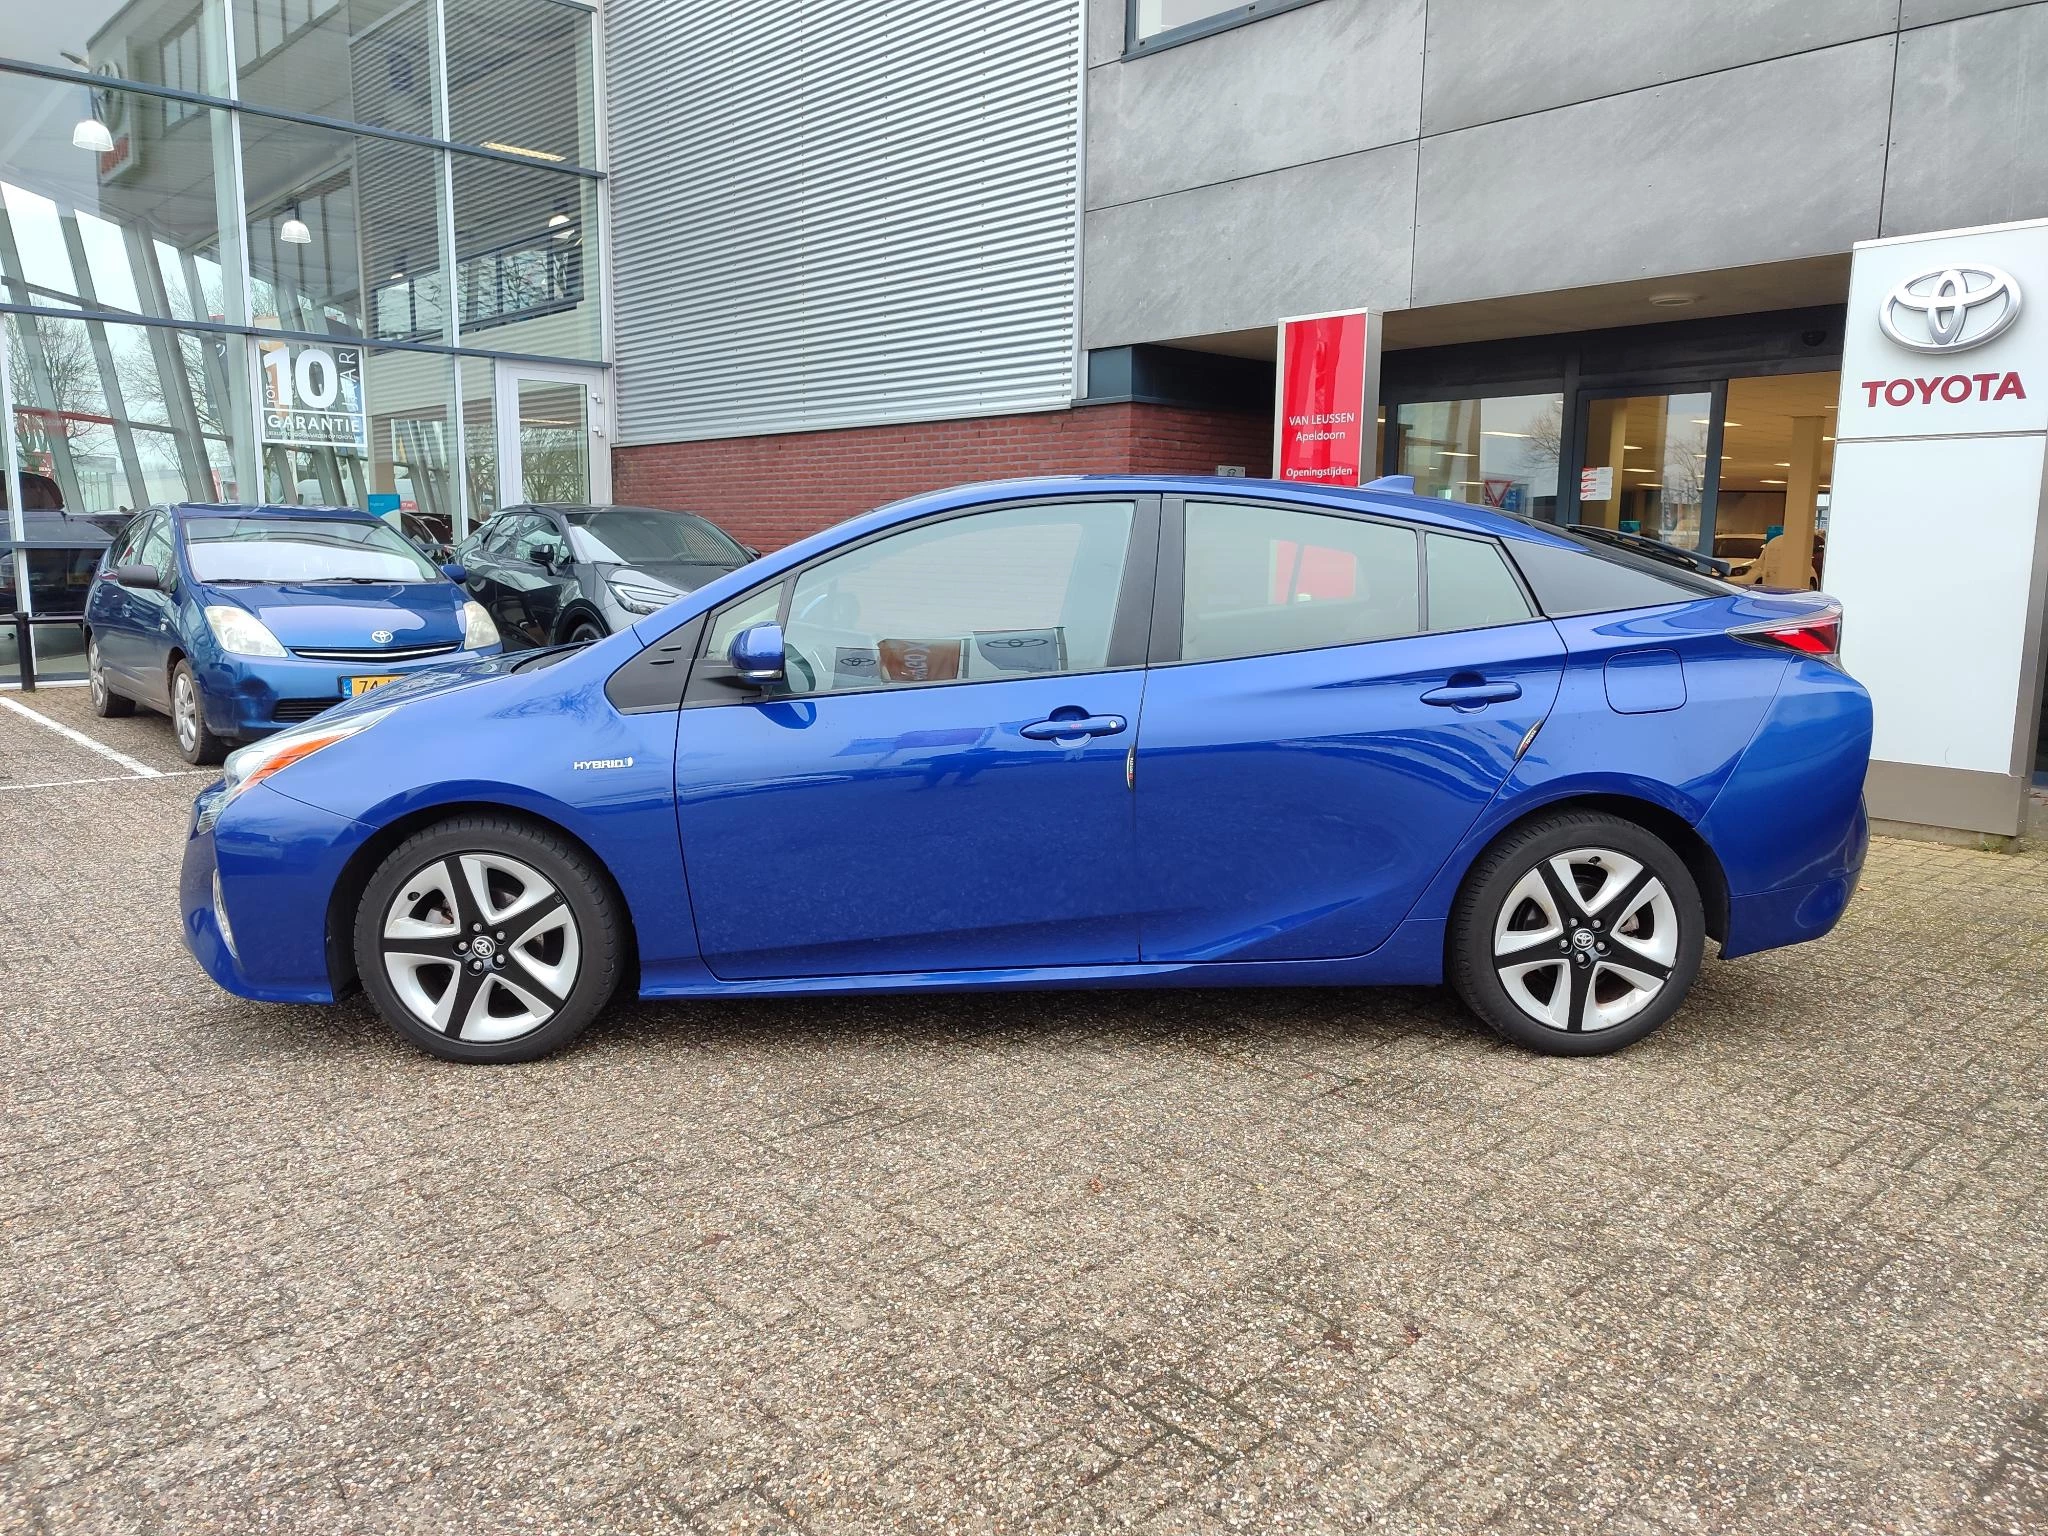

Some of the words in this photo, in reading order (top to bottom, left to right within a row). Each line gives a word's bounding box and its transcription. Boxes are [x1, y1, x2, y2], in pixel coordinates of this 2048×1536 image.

[263, 346, 338, 409] 10
[1861, 371, 2027, 408] TOYOTA
[267, 414, 361, 433] GARANTIE
[1289, 415, 1309, 426] VAN
[1311, 412, 1355, 425] LEUSSEN
[1295, 430, 1346, 443] Apeldoorn
[1286, 466, 1353, 479] Openingstijden
[573, 758, 626, 770] HYBRID
